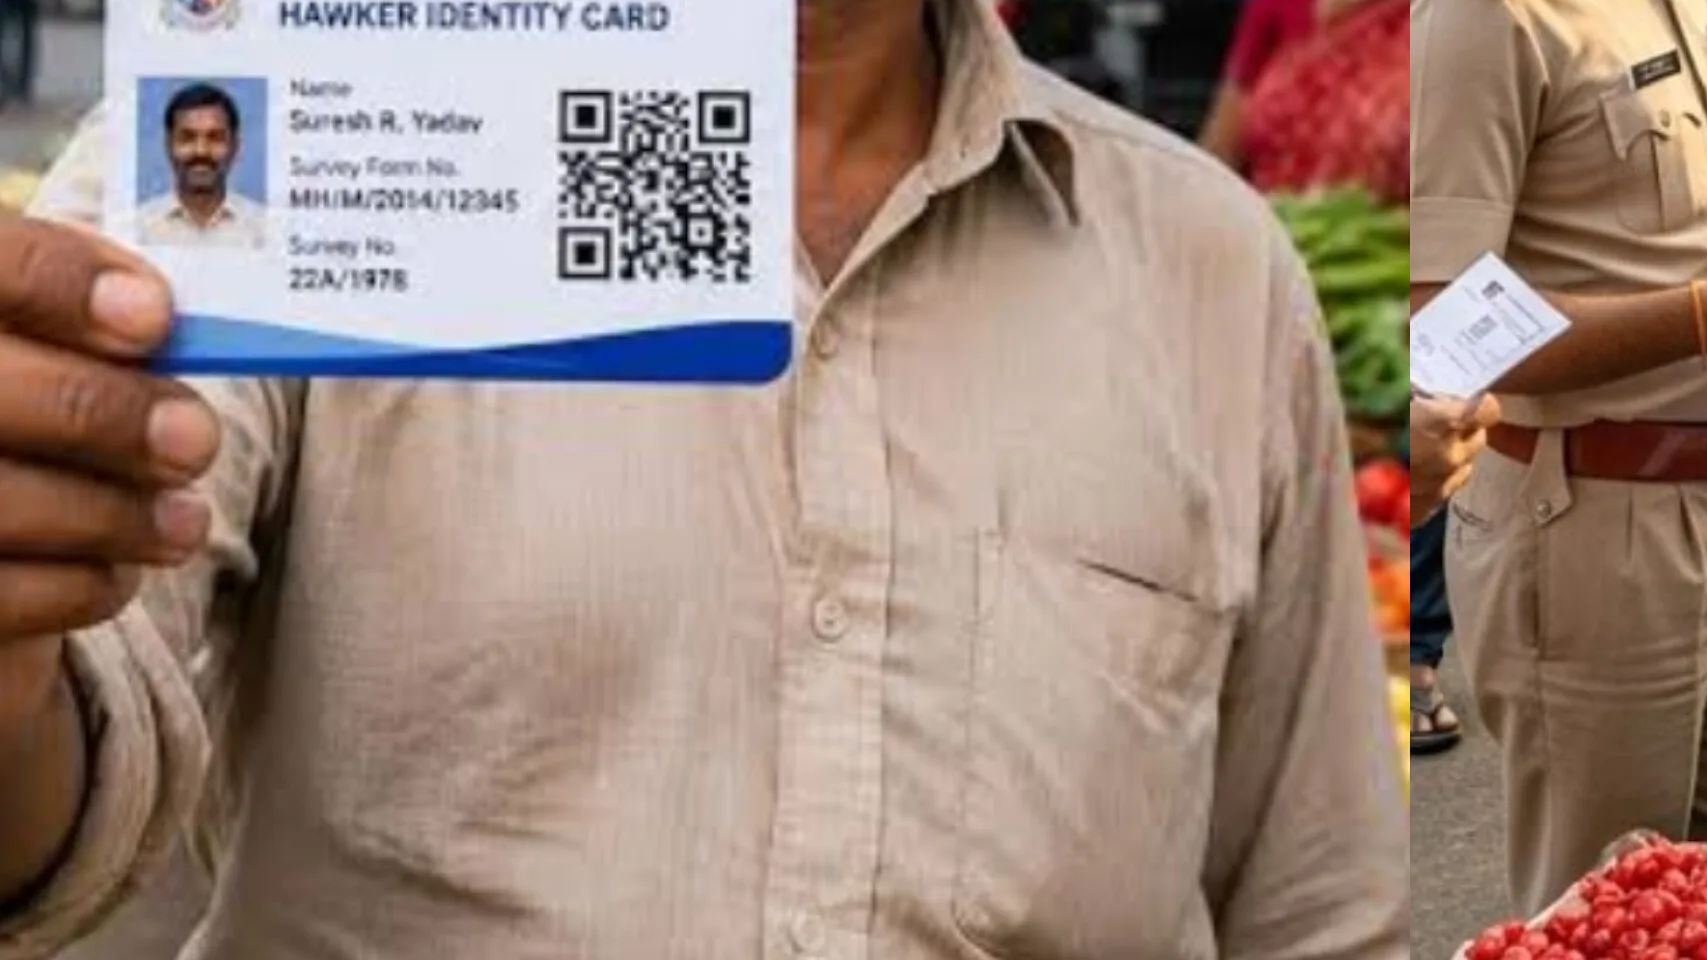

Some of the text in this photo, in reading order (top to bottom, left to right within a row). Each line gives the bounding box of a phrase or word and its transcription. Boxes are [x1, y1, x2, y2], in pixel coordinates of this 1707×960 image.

[279, 1, 671, 32] HAWKER IDENTITY CARD
[289, 79, 352, 98] Name
[289, 108, 484, 134] Suresh R. Yadav
[289, 155, 361, 180] Survey
[366, 156, 421, 177] Form
[289, 234, 360, 260] Survey
